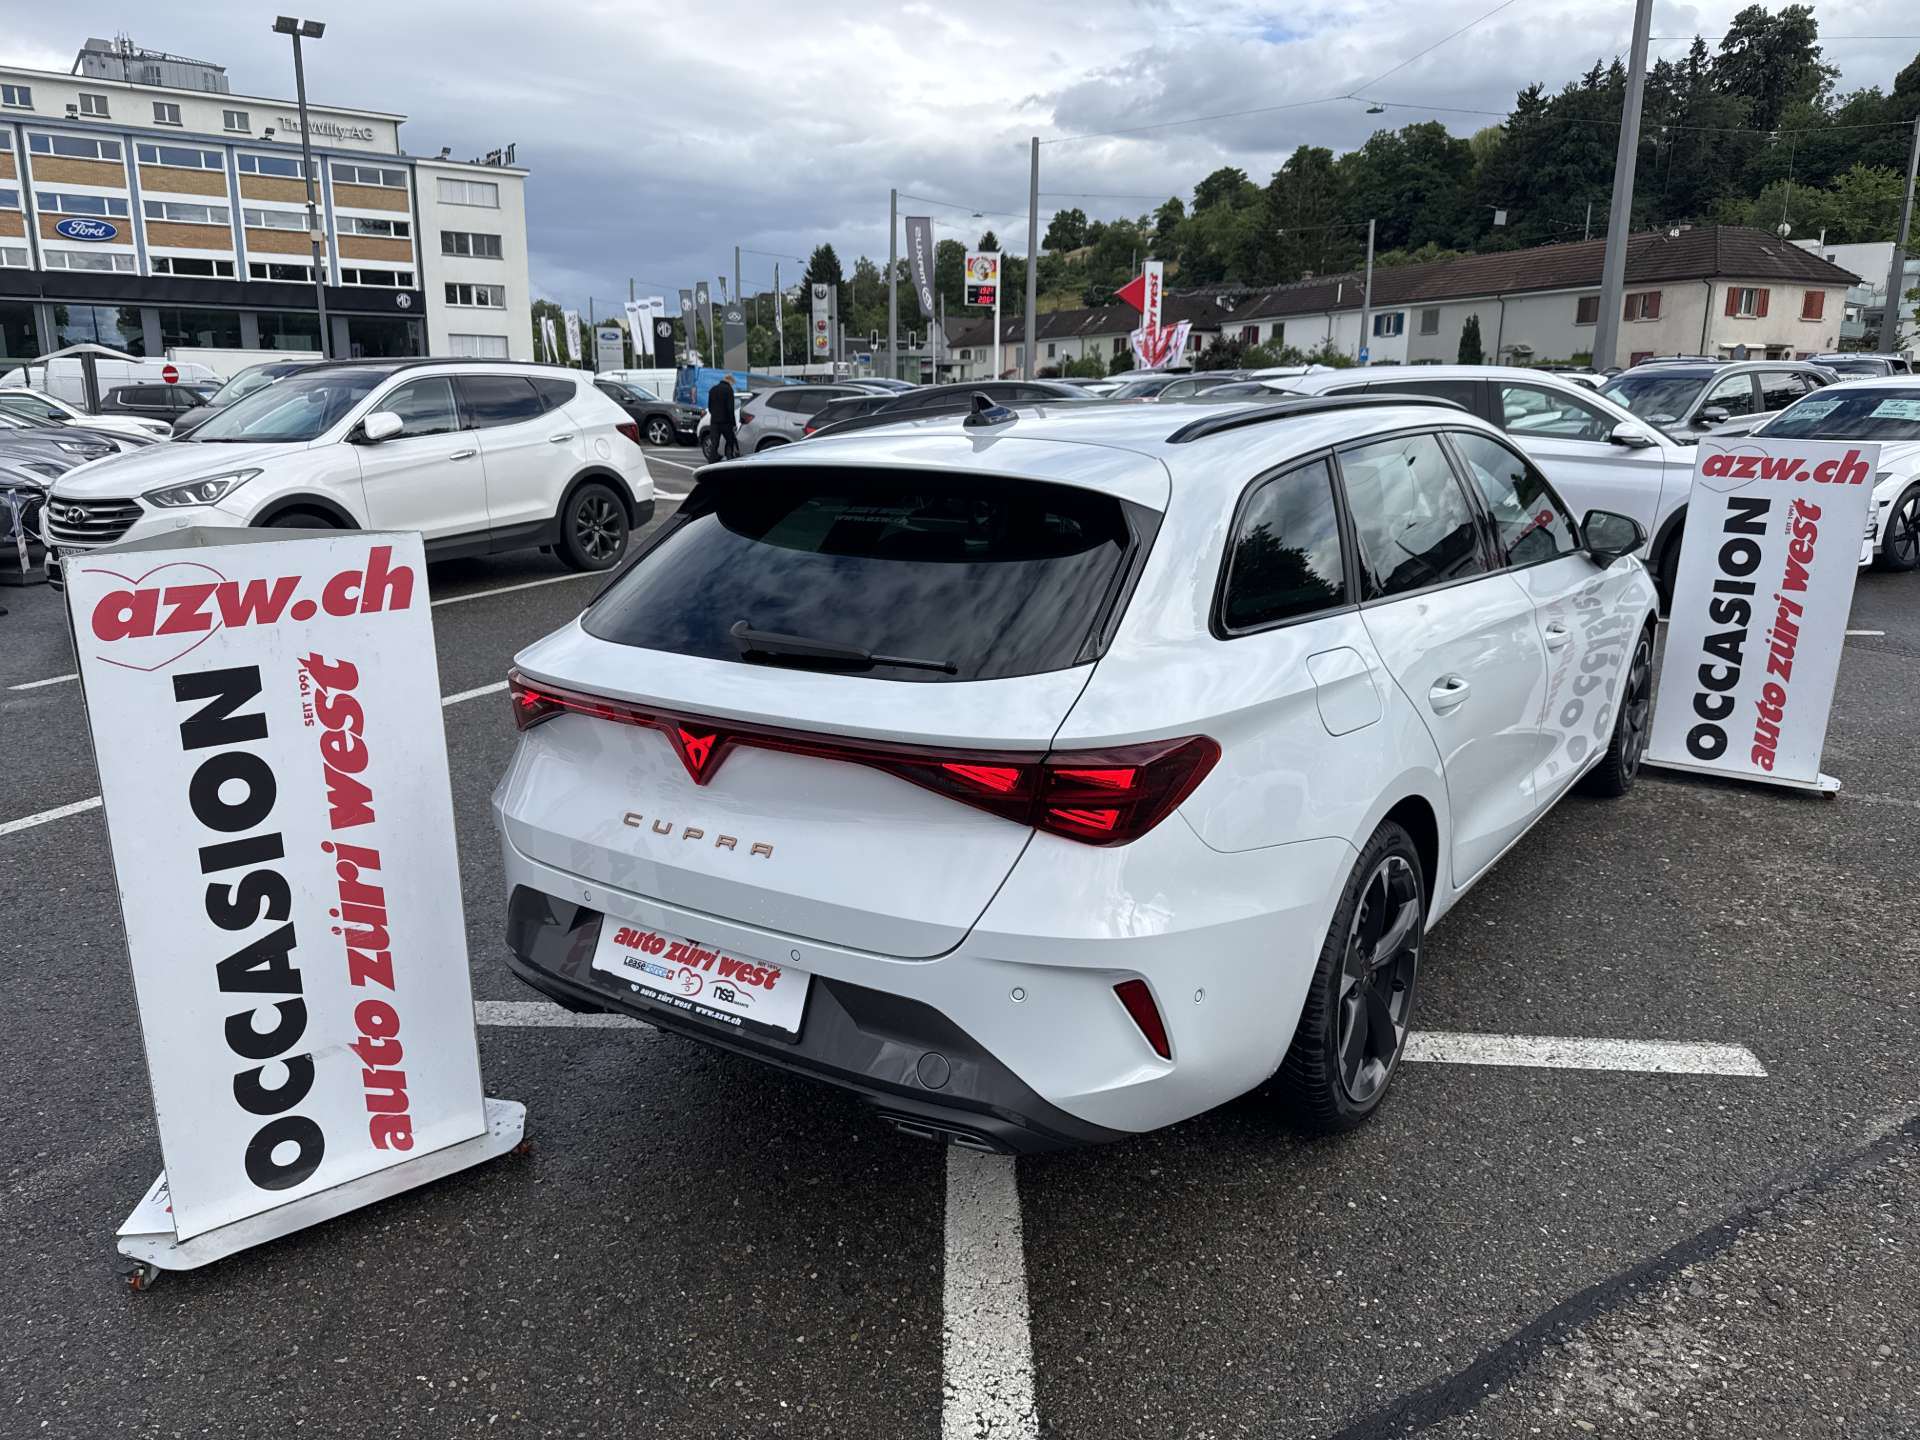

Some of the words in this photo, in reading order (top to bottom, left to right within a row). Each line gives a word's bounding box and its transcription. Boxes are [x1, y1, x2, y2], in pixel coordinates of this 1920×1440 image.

[309, 120, 346, 141] Willy
[351, 126, 375, 140] AG
[68, 220, 106, 237] Ford
[657, 321, 672, 338] MG
[1702, 450, 1869, 486] azw.ch
[1781, 498, 1822, 592] west
[92, 546, 414, 642] azw.ch
[1686, 496, 1771, 761] OCCASION
[1765, 594, 1804, 682] züri
[298, 668, 311, 697] 1991
[302, 702, 315, 727] SEIT
[297, 652, 375, 829] west
[1751, 682, 1787, 771] auto
[623, 812, 774, 859] CUPRA
[173, 665, 325, 1191] OCCASION
[321, 843, 396, 991] züri
[613, 926, 667, 955] auto
[662, 939, 721, 971] züri
[714, 958, 782, 990] west
[640, 988, 657, 998] auto
[673, 999, 693, 1010] west
[713, 985, 735, 1004] nsa
[350, 999, 415, 1151] auto
